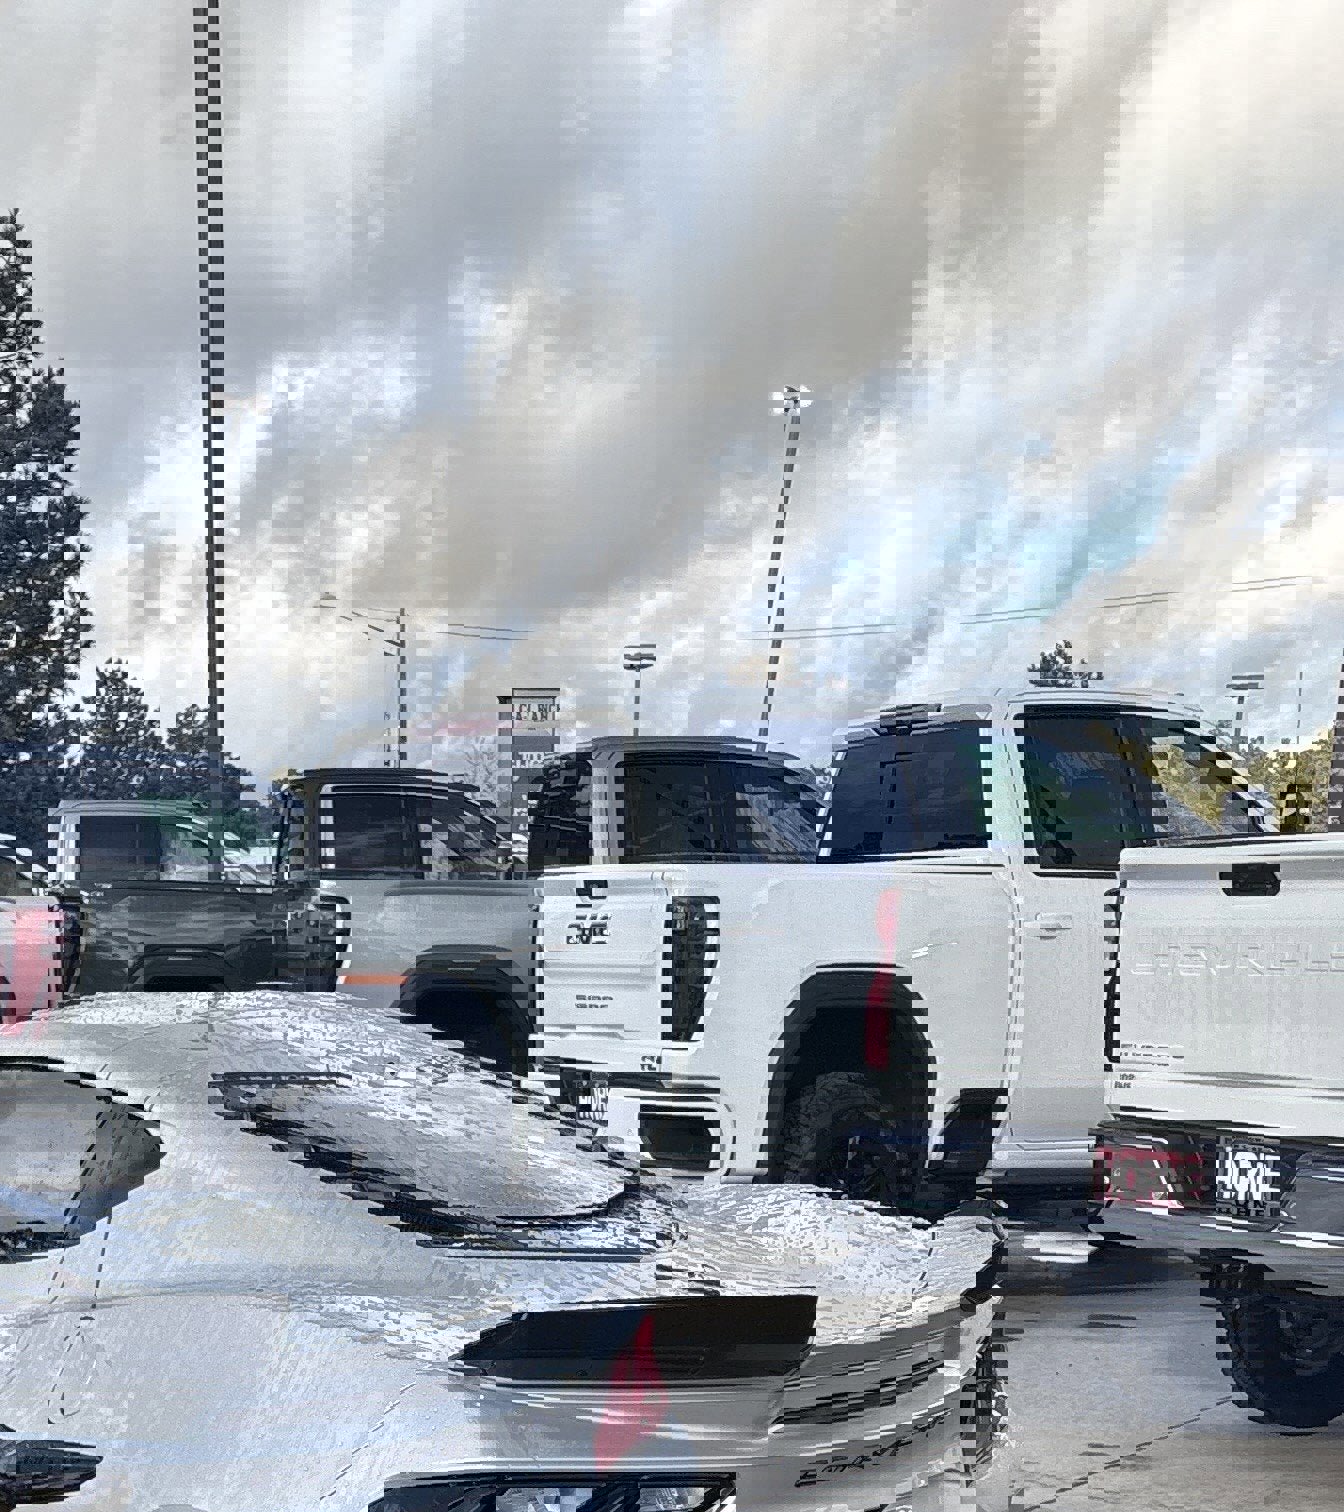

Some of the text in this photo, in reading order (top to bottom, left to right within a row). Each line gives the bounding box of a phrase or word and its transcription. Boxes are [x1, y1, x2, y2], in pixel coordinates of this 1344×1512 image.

[896, 1051, 1010, 1067] SILVERADO
[1098, 1155, 1203, 1208] HORNE
[250, 1406, 559, 1488] CORVETTE
